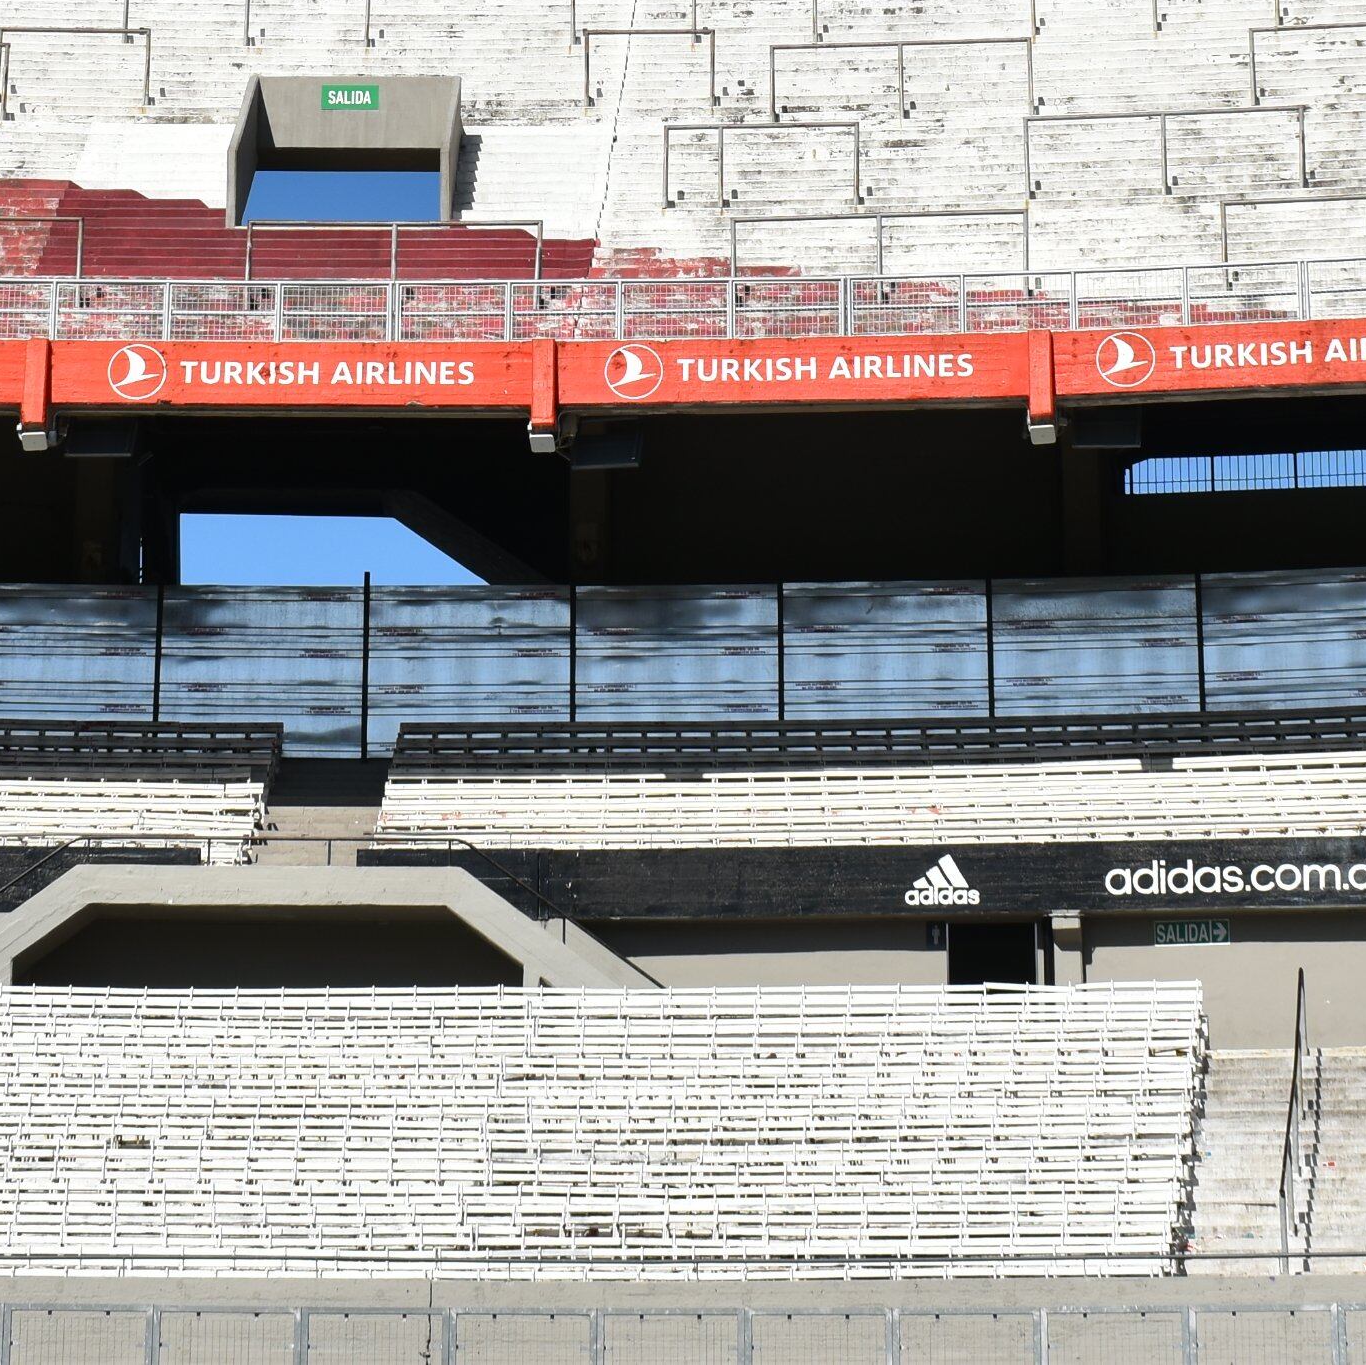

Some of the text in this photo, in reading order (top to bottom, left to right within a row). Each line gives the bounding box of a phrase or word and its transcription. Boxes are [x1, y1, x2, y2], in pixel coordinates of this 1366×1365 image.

[327, 90, 372, 105] SALIDA
[1168, 340, 1313, 370] TURKISH
[179, 360, 475, 385] TURKISH AIRLINES
[676, 353, 974, 382] TURKISH AIRLINES
[904, 885, 981, 906] adidas
[1156, 923, 1209, 943] SALIDA
